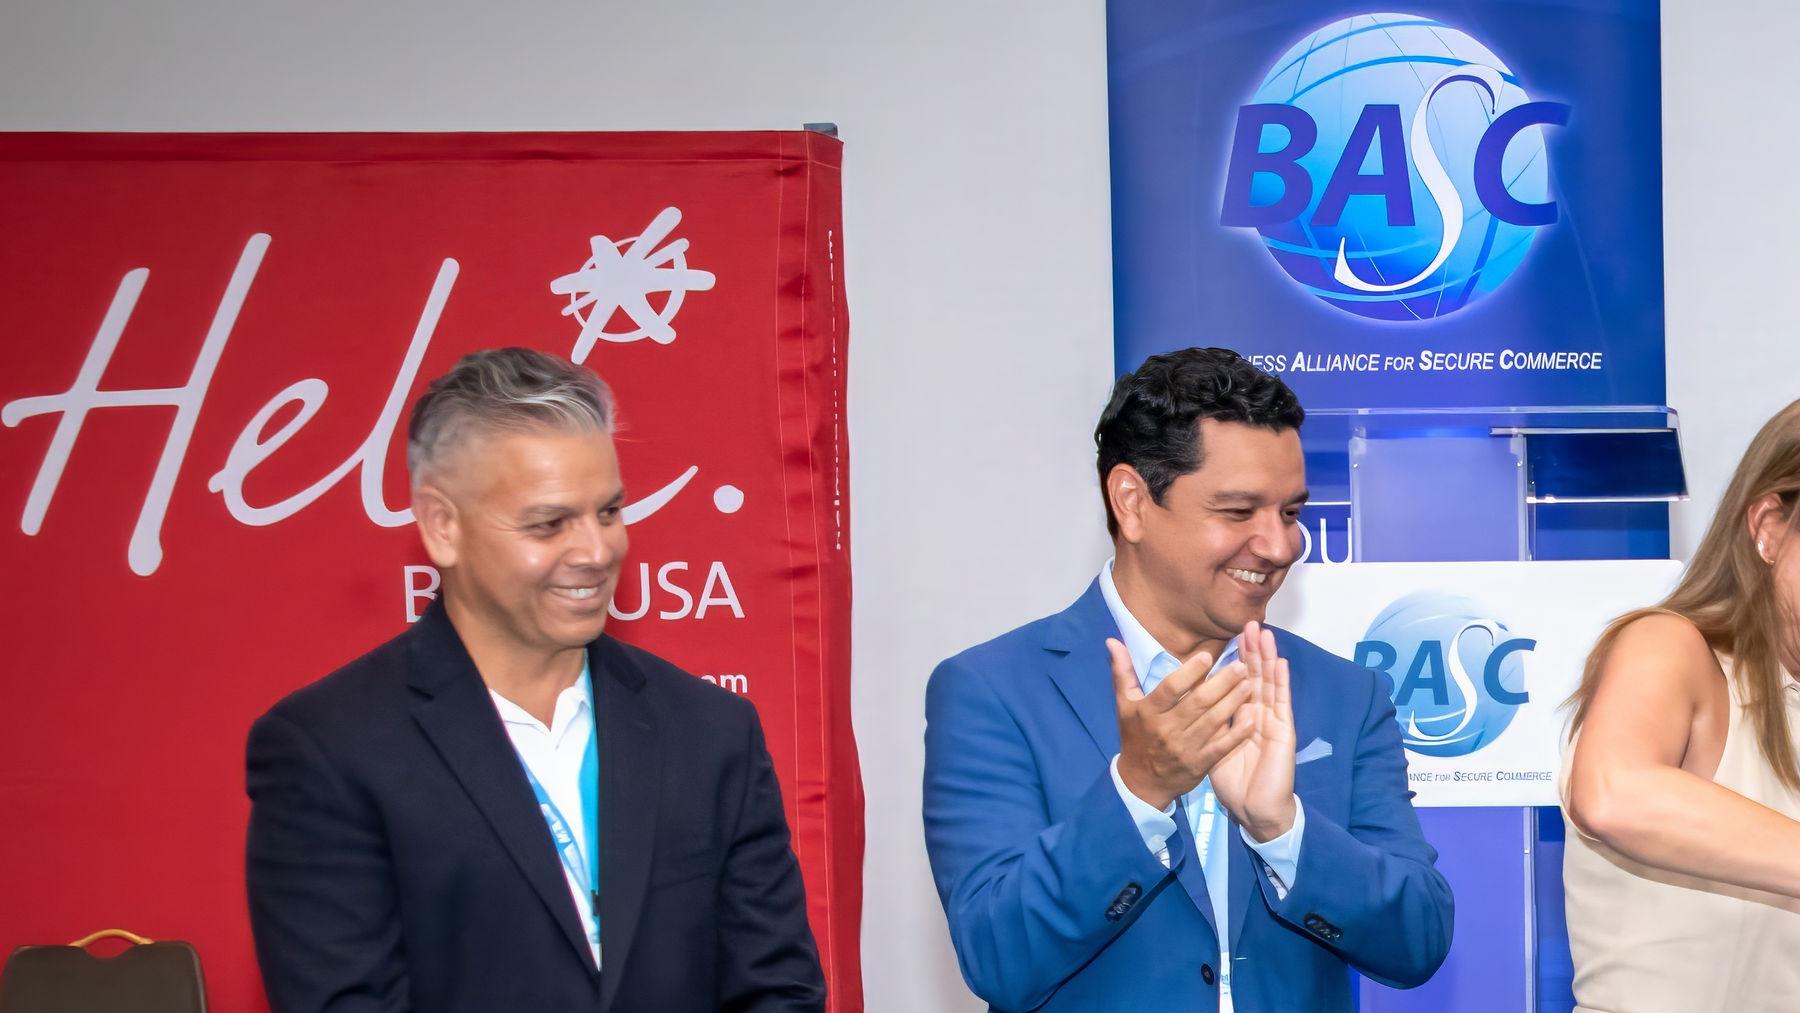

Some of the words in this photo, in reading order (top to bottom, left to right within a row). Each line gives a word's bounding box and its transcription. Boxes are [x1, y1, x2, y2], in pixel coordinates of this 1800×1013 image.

[1219, 63, 1574, 293] BASC
[1290, 352, 1380, 372] ALLIANCE
[1384, 355, 1415, 371] FOR
[1418, 349, 1495, 371] SECURE
[1499, 349, 1603, 371] COMMERCE
[607, 561, 745, 621] USA
